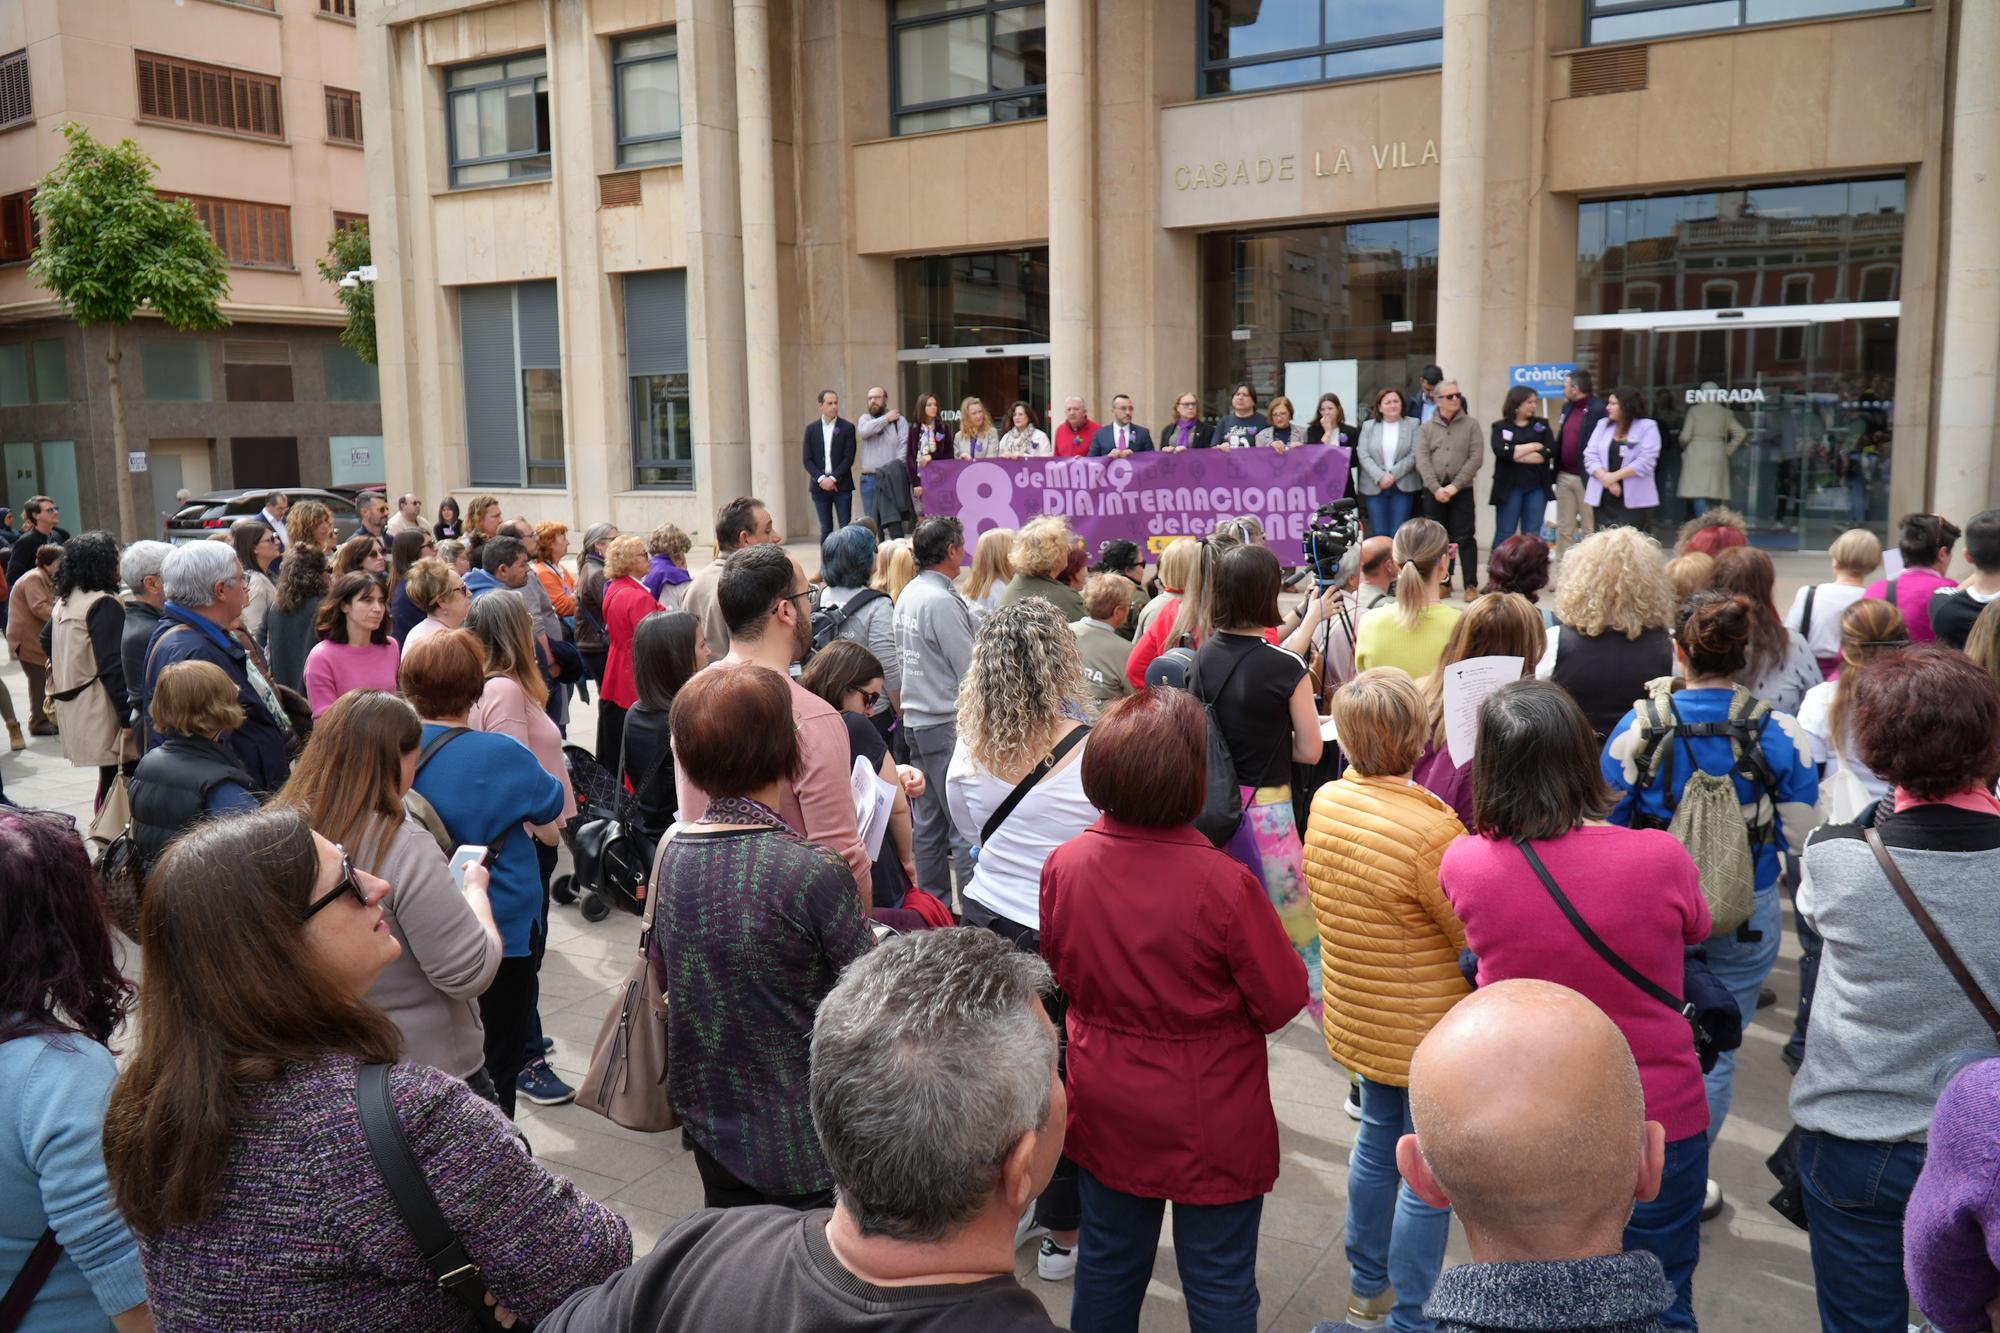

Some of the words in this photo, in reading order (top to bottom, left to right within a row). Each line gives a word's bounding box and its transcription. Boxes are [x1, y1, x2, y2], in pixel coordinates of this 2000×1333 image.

[1314, 148, 1352, 177] LA
[1371, 138, 1440, 171] VILA
[1685, 388, 1766, 404] ENTRADA
[956, 461, 1020, 558] 8
[1014, 467, 1045, 489] de
[1042, 488, 1095, 518] DIA
[1098, 486, 1319, 517] INTERNACIONAL
